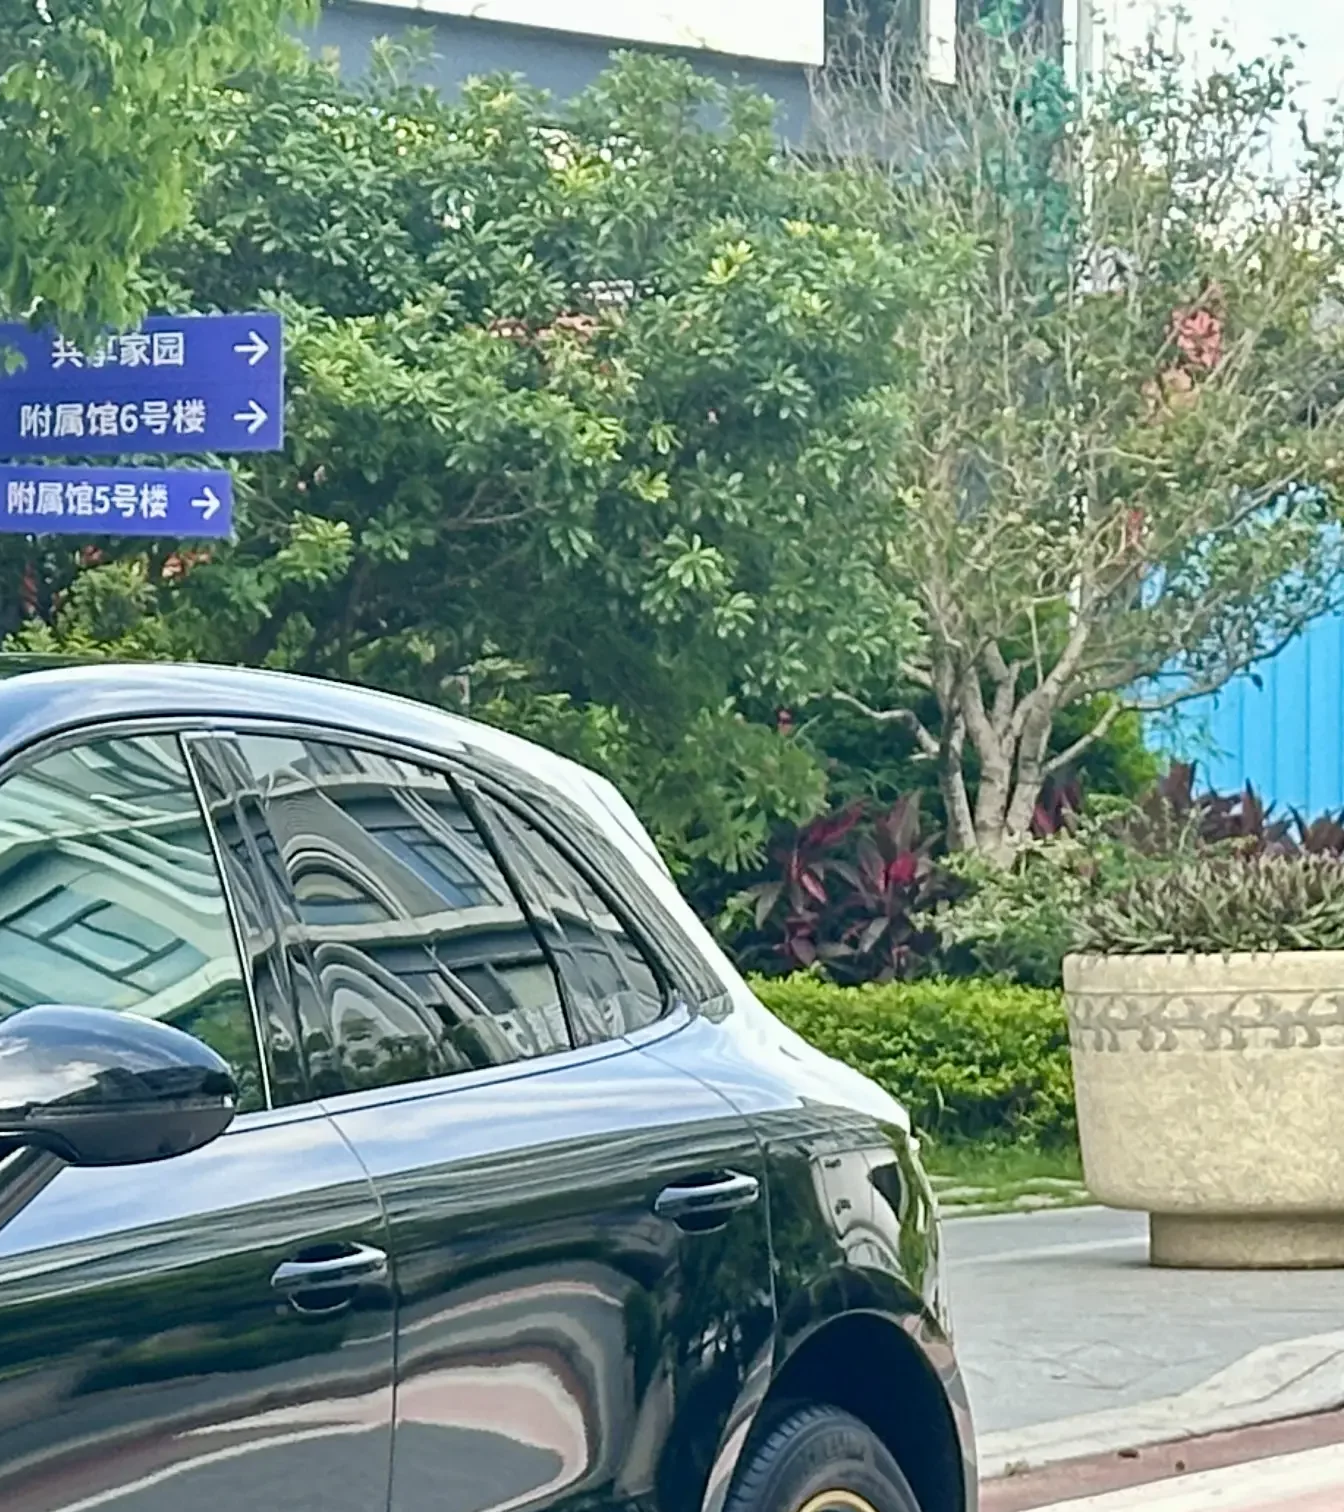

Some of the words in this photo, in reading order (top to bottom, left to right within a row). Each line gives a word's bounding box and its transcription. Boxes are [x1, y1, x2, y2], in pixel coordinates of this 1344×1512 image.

[20, 398, 206, 437] 附属馆6号楼
[7, 481, 168, 519] 附属馆5号楼
